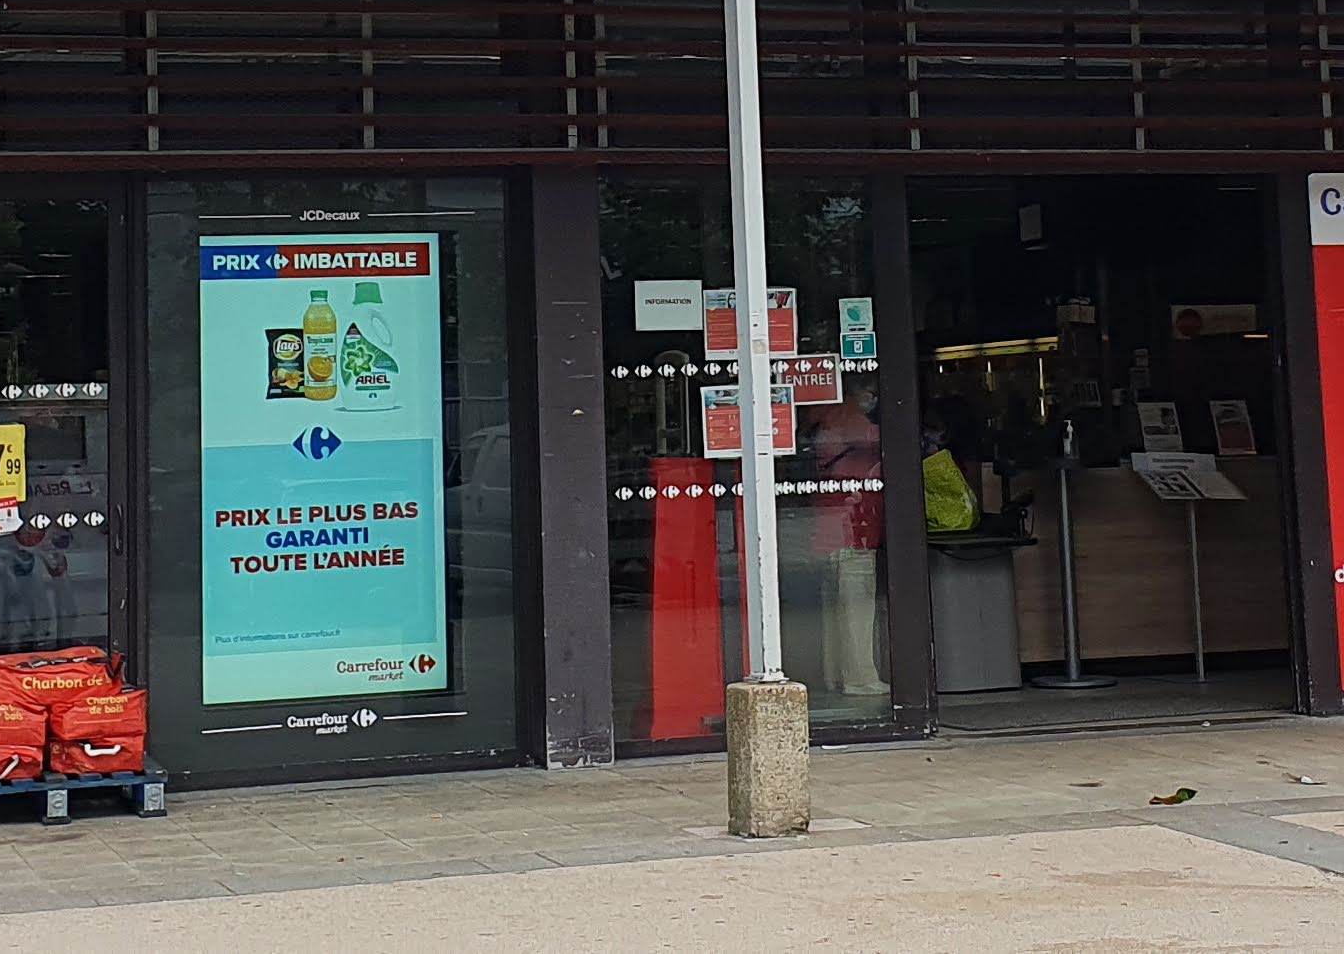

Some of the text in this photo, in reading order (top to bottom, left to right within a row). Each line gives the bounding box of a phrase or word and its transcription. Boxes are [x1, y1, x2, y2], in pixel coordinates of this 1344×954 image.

[299, 210, 360, 221] JCDecaux
[213, 251, 417, 271] PRIX IMBATTABLE
[645, 298, 692, 306] INFORMATION
[355, 373, 391, 385] ARIEL
[215, 502, 418, 527] PRIX LE PLUS BAS
[265, 527, 369, 548] GARANTI
[230, 553, 307, 573] TOUTE
[214, 635, 232, 644] Plus
[336, 657, 404, 674] Carrefour
[22, 674, 103, 691] Charbon de
[368, 671, 404, 682] market
[4, 710, 24, 721] bois
[89, 704, 124, 715] de bois
[286, 712, 348, 728] Carrefour
[315, 724, 348, 735] market
